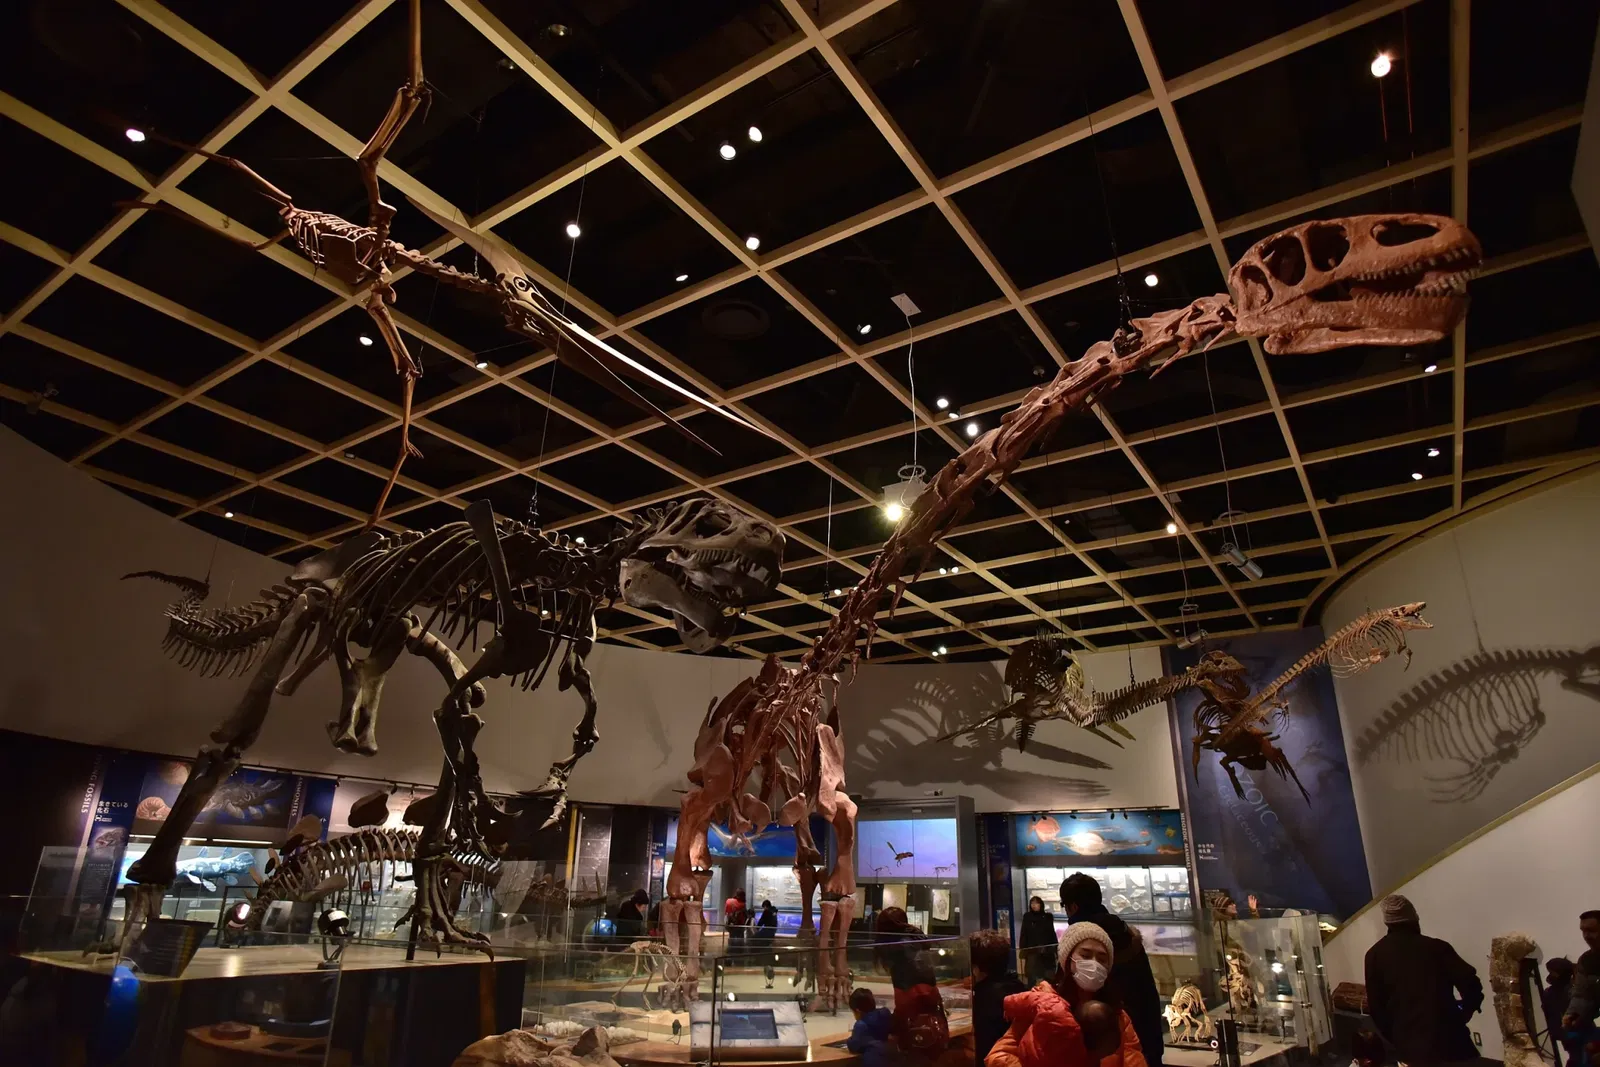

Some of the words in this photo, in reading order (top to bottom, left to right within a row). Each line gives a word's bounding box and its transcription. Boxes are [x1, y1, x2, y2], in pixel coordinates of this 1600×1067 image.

[81, 783, 95, 814] FOSSILS
[291, 777, 303, 817] AMMONITES
[1180, 812, 1188, 841] MESOZOIC
[1183, 842, 1192, 872] MAMMALS
